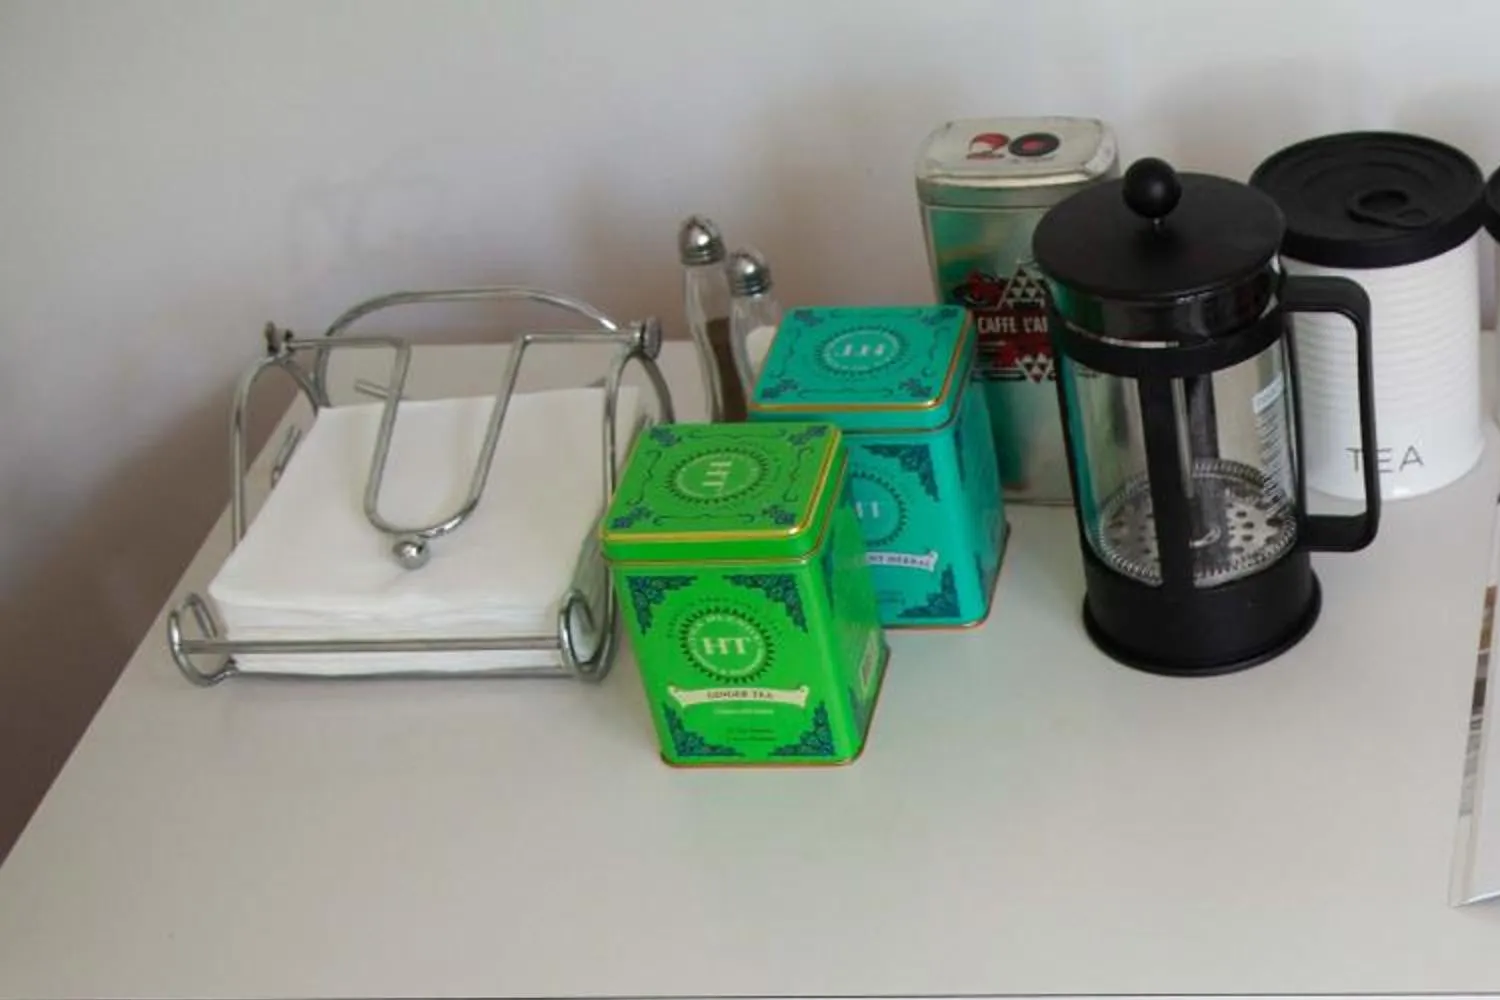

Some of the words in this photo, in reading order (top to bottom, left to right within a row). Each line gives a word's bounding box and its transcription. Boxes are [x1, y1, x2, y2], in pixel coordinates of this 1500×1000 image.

[977, 316, 1018, 334] CAFFE
[1346, 445, 1425, 473] TEA
[702, 636, 752, 656] HT
